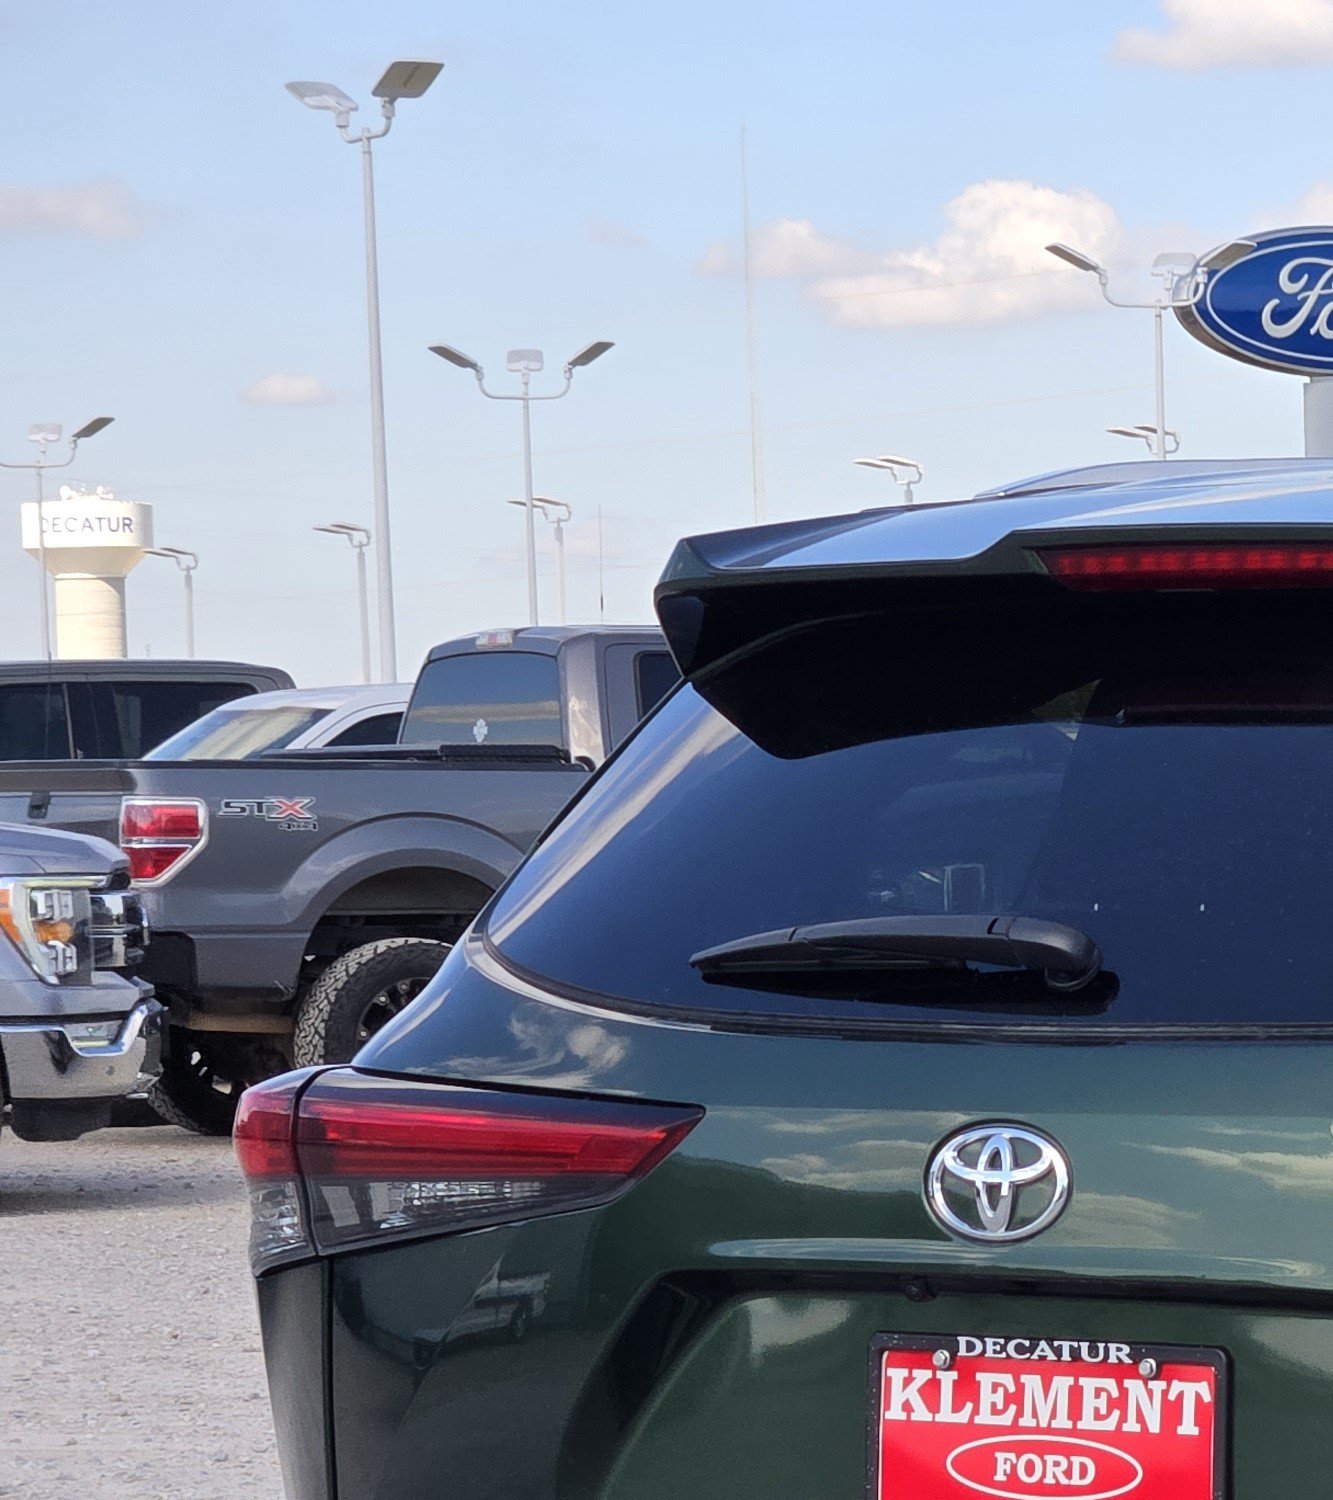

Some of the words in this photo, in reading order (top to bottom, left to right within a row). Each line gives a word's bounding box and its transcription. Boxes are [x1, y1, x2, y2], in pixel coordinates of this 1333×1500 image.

[40, 516, 134, 534] DECATUR
[217, 796, 317, 821] STX
[957, 1336, 1133, 1364] DECATUR
[884, 1367, 1211, 1436] KLEMENT
[994, 1451, 1096, 1486] FORD
